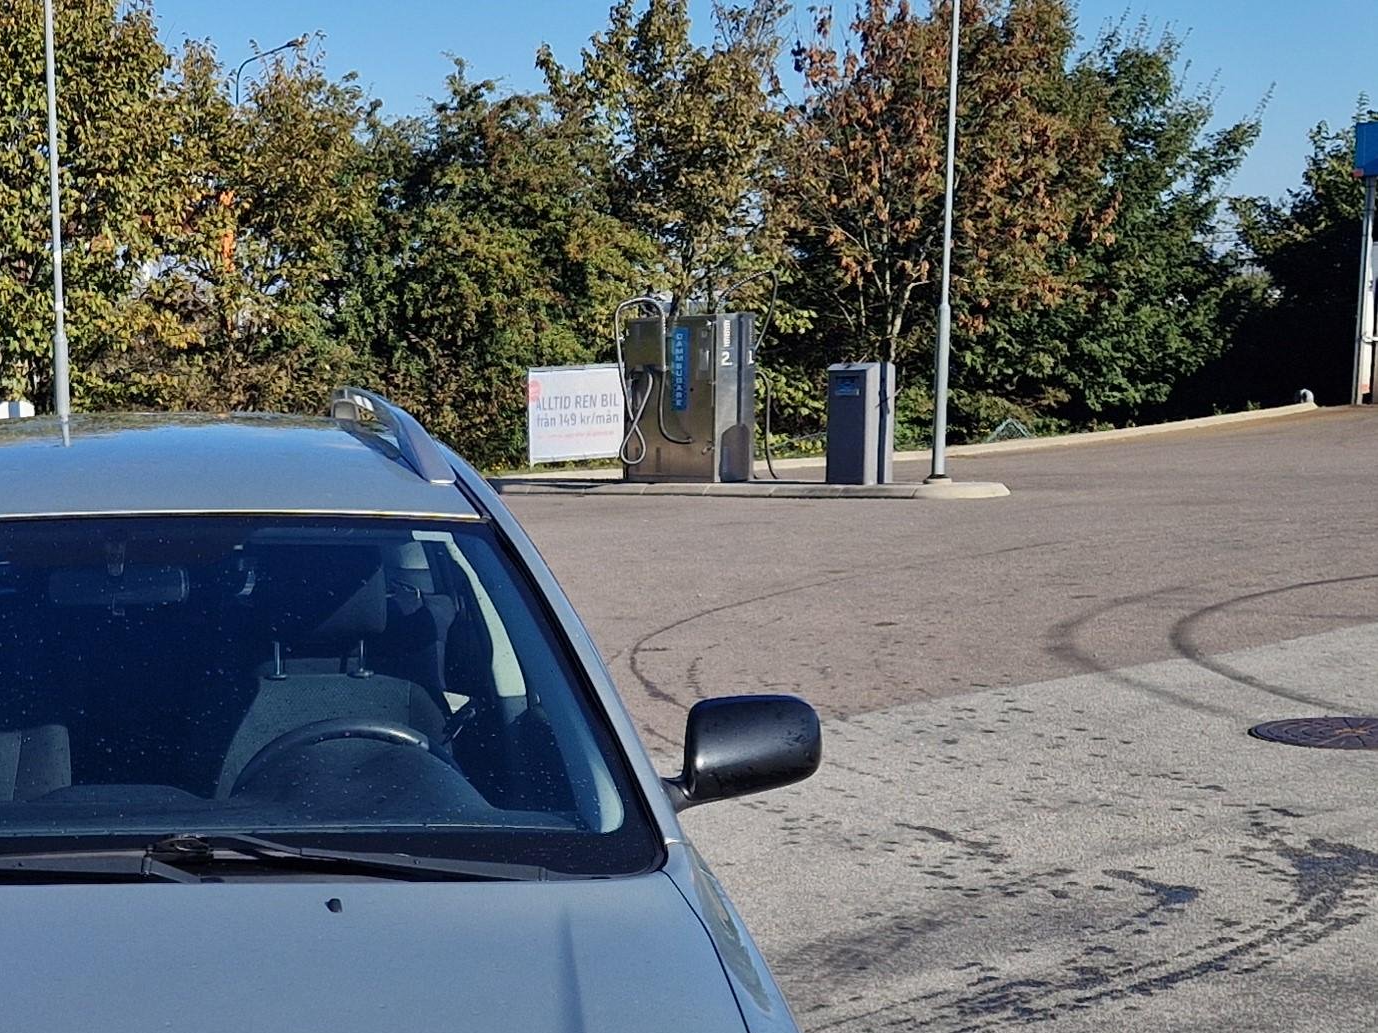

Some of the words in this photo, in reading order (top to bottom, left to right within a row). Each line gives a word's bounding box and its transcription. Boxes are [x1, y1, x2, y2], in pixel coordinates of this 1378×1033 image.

[536, 395, 571, 411] ALLTID
[575, 394, 598, 409] REN
[601, 393, 620, 408] BIL
[537, 412, 556, 428] från
[559, 413, 577, 427] 149
[580, 410, 619, 426] kr/mån
